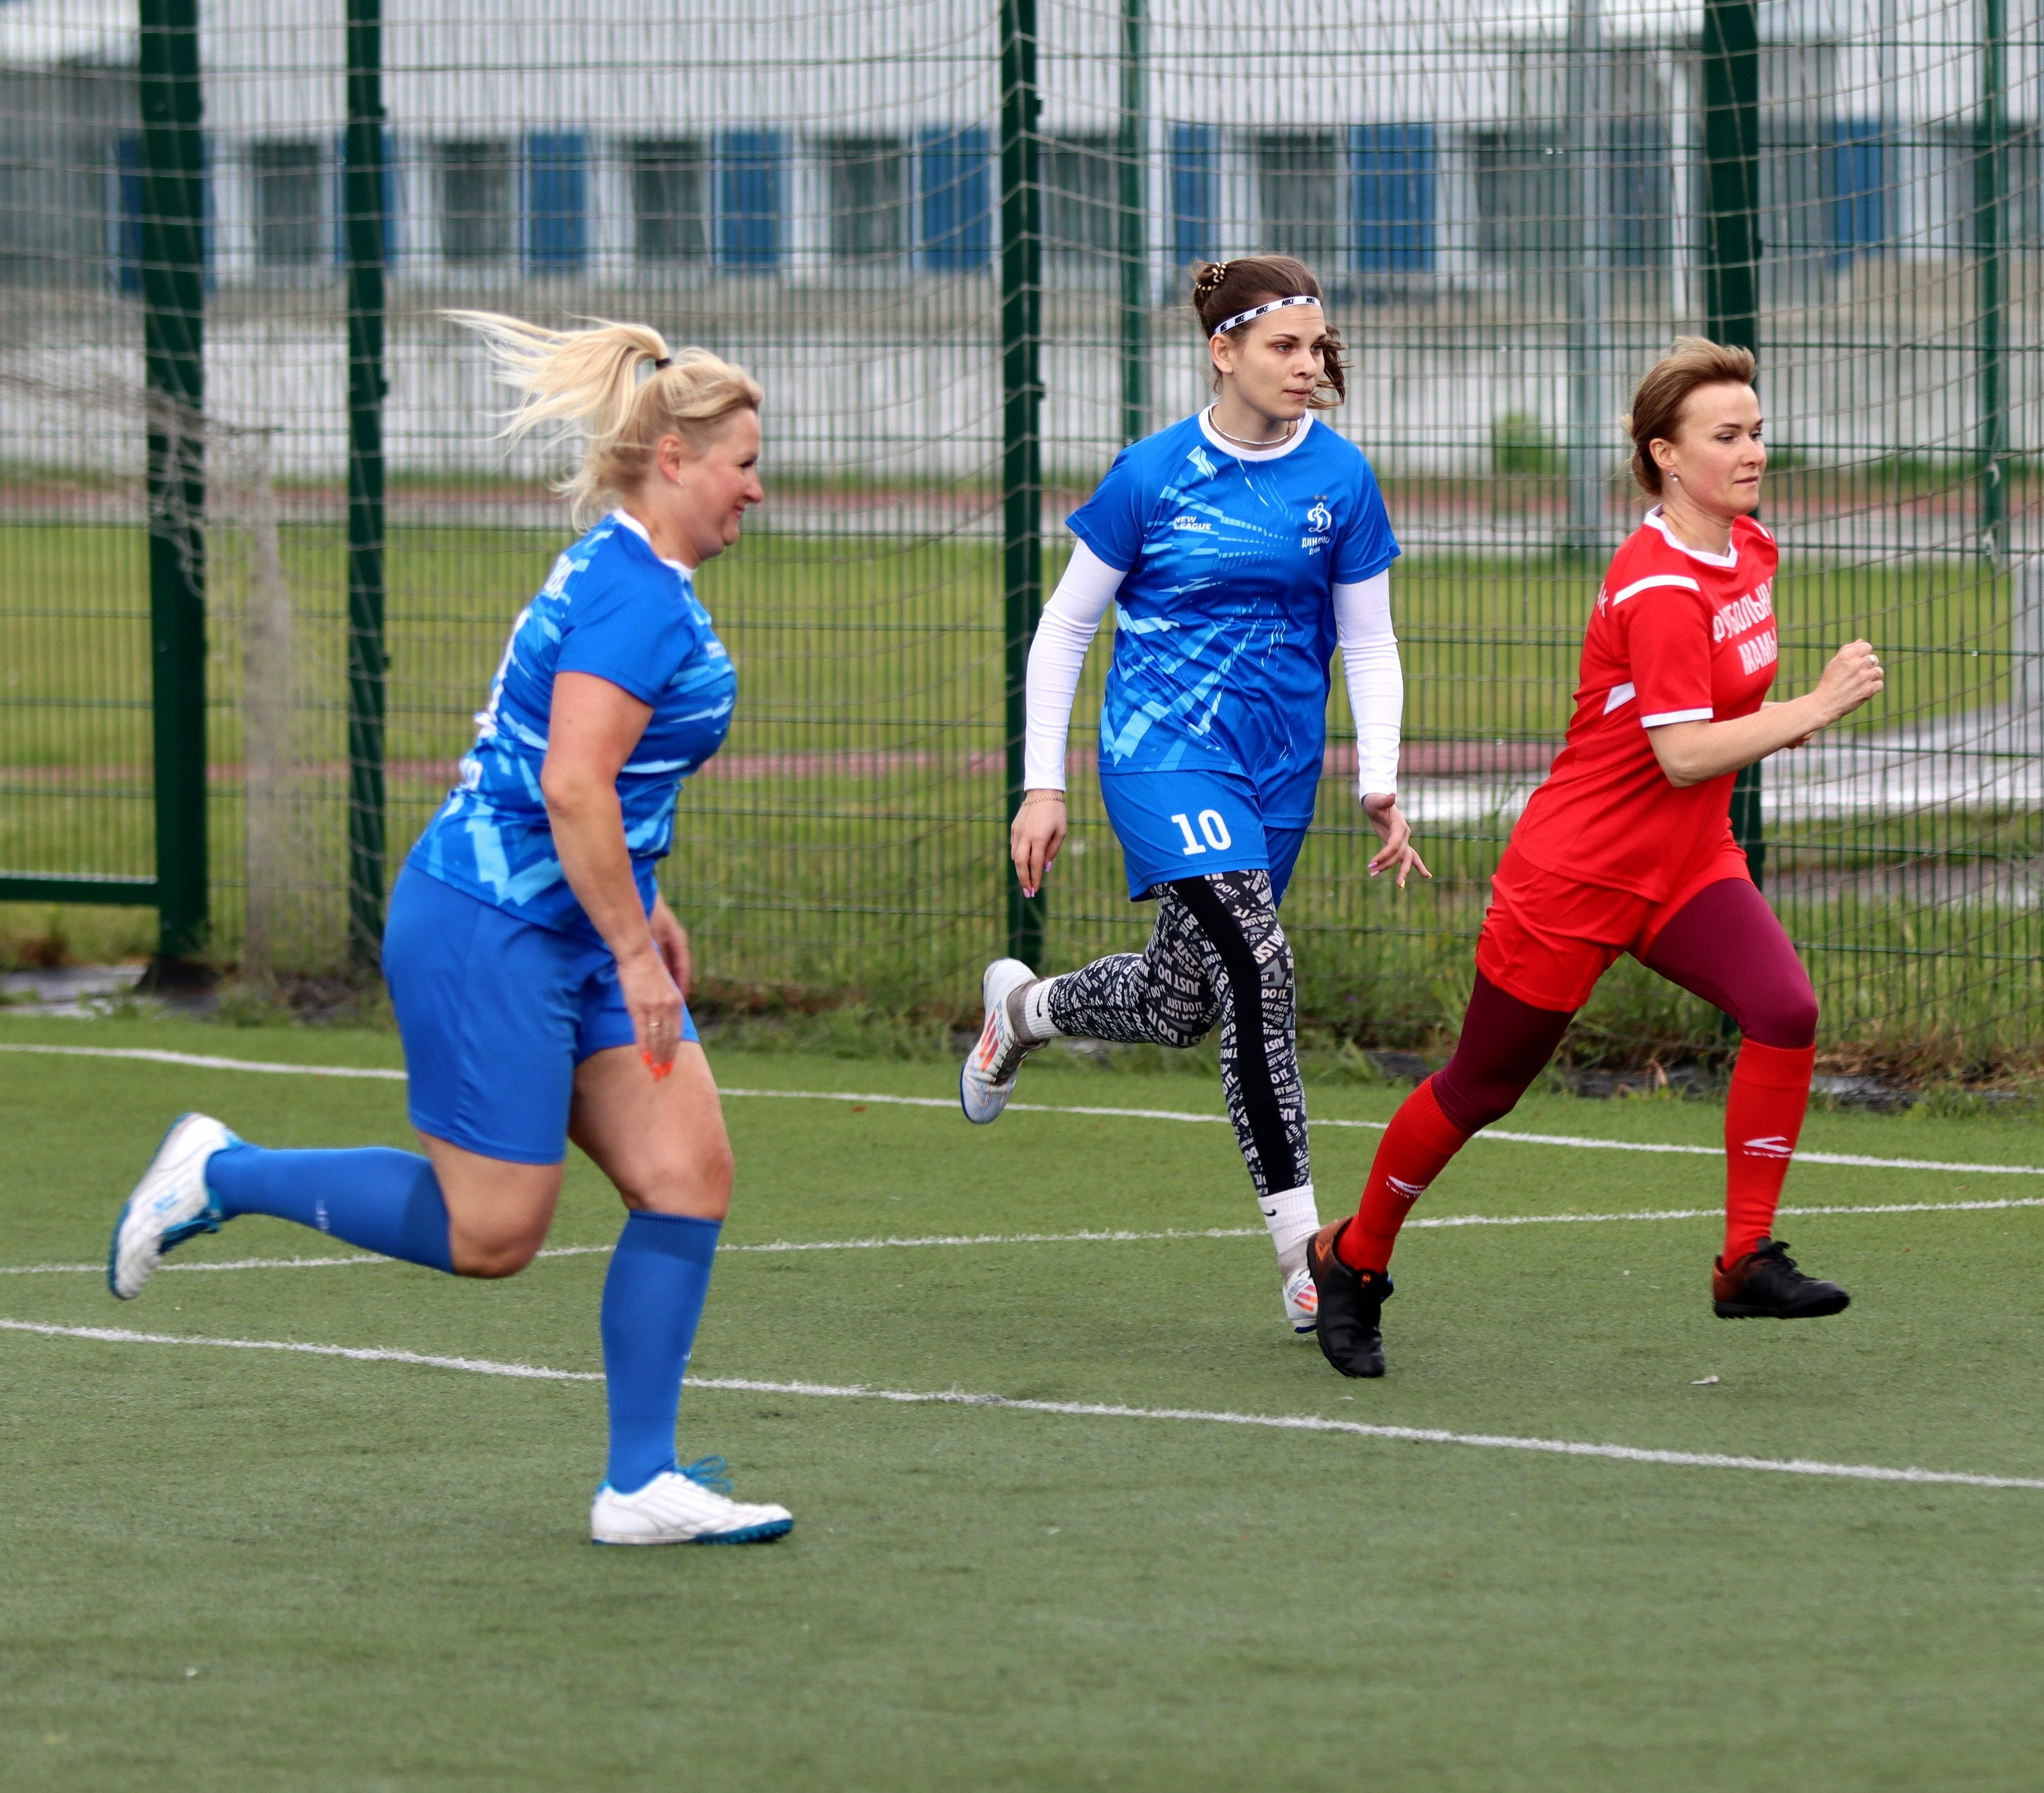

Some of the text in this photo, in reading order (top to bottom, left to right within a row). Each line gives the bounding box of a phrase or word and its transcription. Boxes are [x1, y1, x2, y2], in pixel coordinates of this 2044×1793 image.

[1256, 305, 1270, 315] NIKE
[1281, 298, 1295, 307] NIKE
[1171, 809, 1232, 856] 10
[1157, 963, 1201, 996] JUST DO
[1262, 988, 1288, 999] DO IT.
[1167, 996, 1182, 1011] JUST
[1182, 1000, 1195, 1012] DO
[1264, 1036, 1285, 1054] JUST
